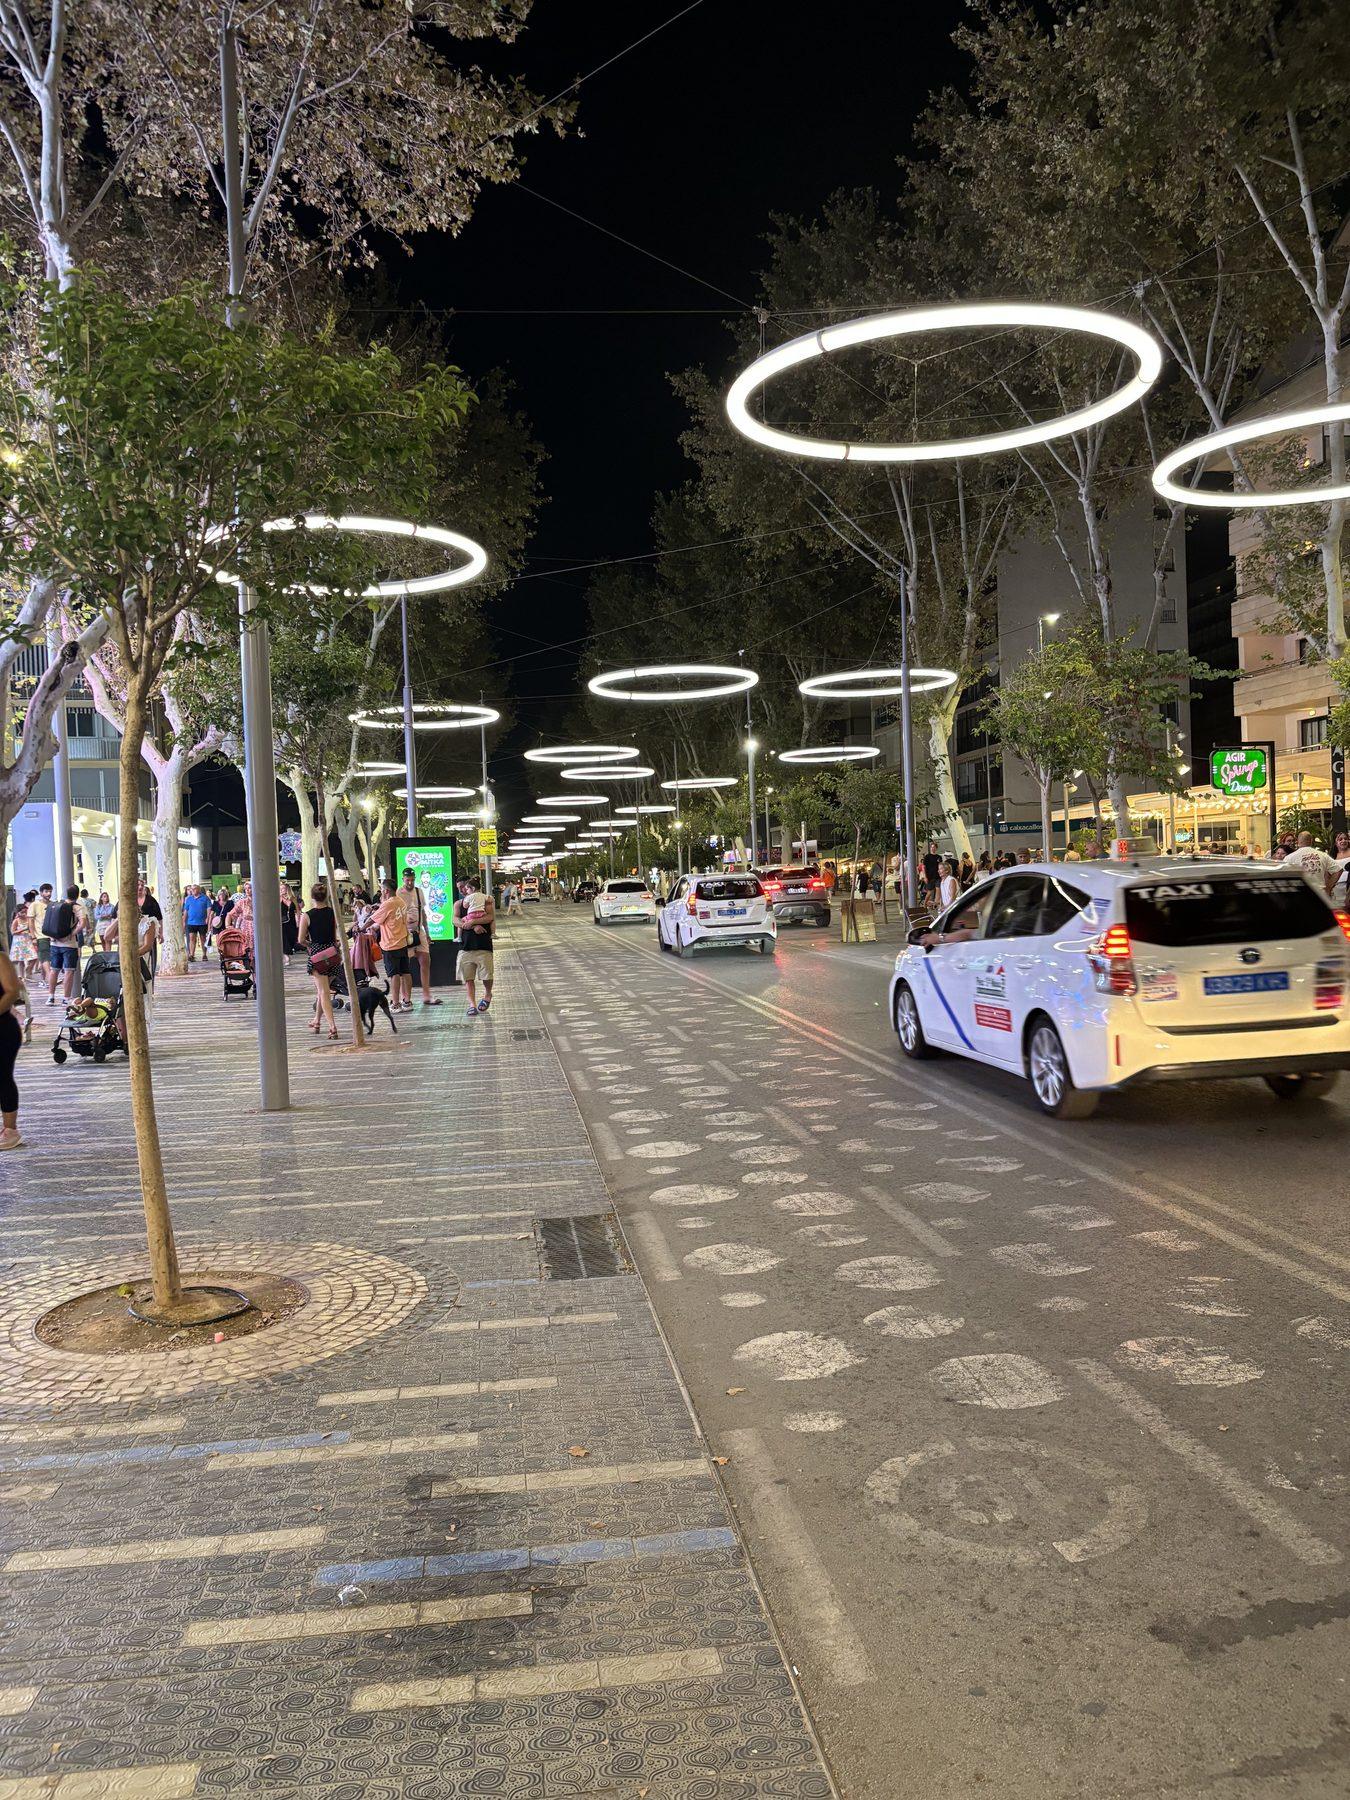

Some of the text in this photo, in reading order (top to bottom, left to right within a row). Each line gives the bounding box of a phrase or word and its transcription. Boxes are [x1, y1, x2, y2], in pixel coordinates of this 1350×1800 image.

[1225, 752, 1246, 762] AGIR
[1332, 746, 1344, 807] AGIR
[1130, 883, 1214, 899] TAXI
